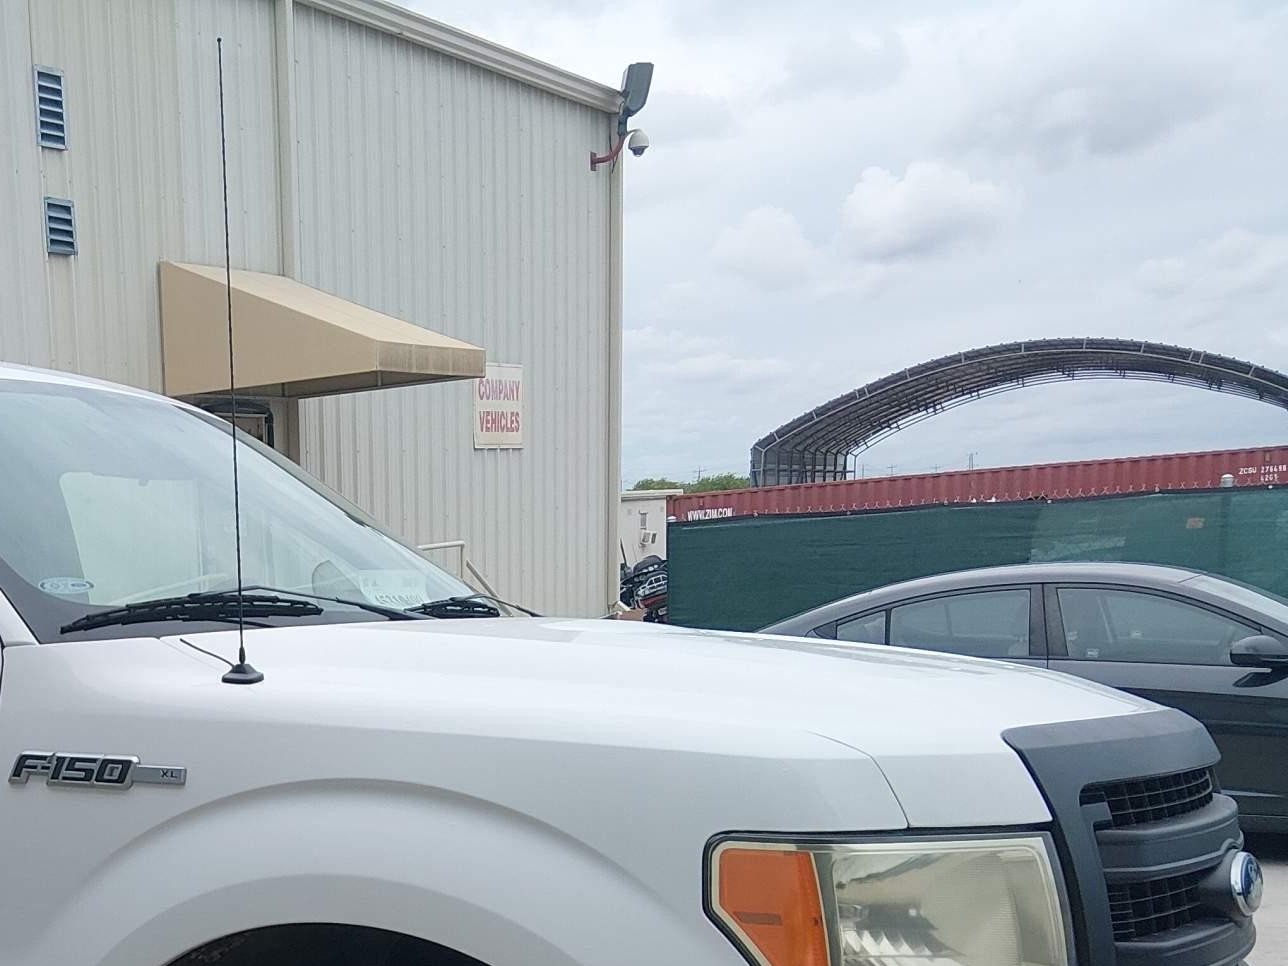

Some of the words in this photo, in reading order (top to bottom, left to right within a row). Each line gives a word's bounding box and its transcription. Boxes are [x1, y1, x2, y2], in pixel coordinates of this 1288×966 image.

[478, 379, 520, 401] COMPANY
[479, 411, 520, 433] VEHICLES
[1238, 467, 1257, 475] ZCSU
[9, 750, 140, 790] F-150
[161, 769, 178, 779] XL
